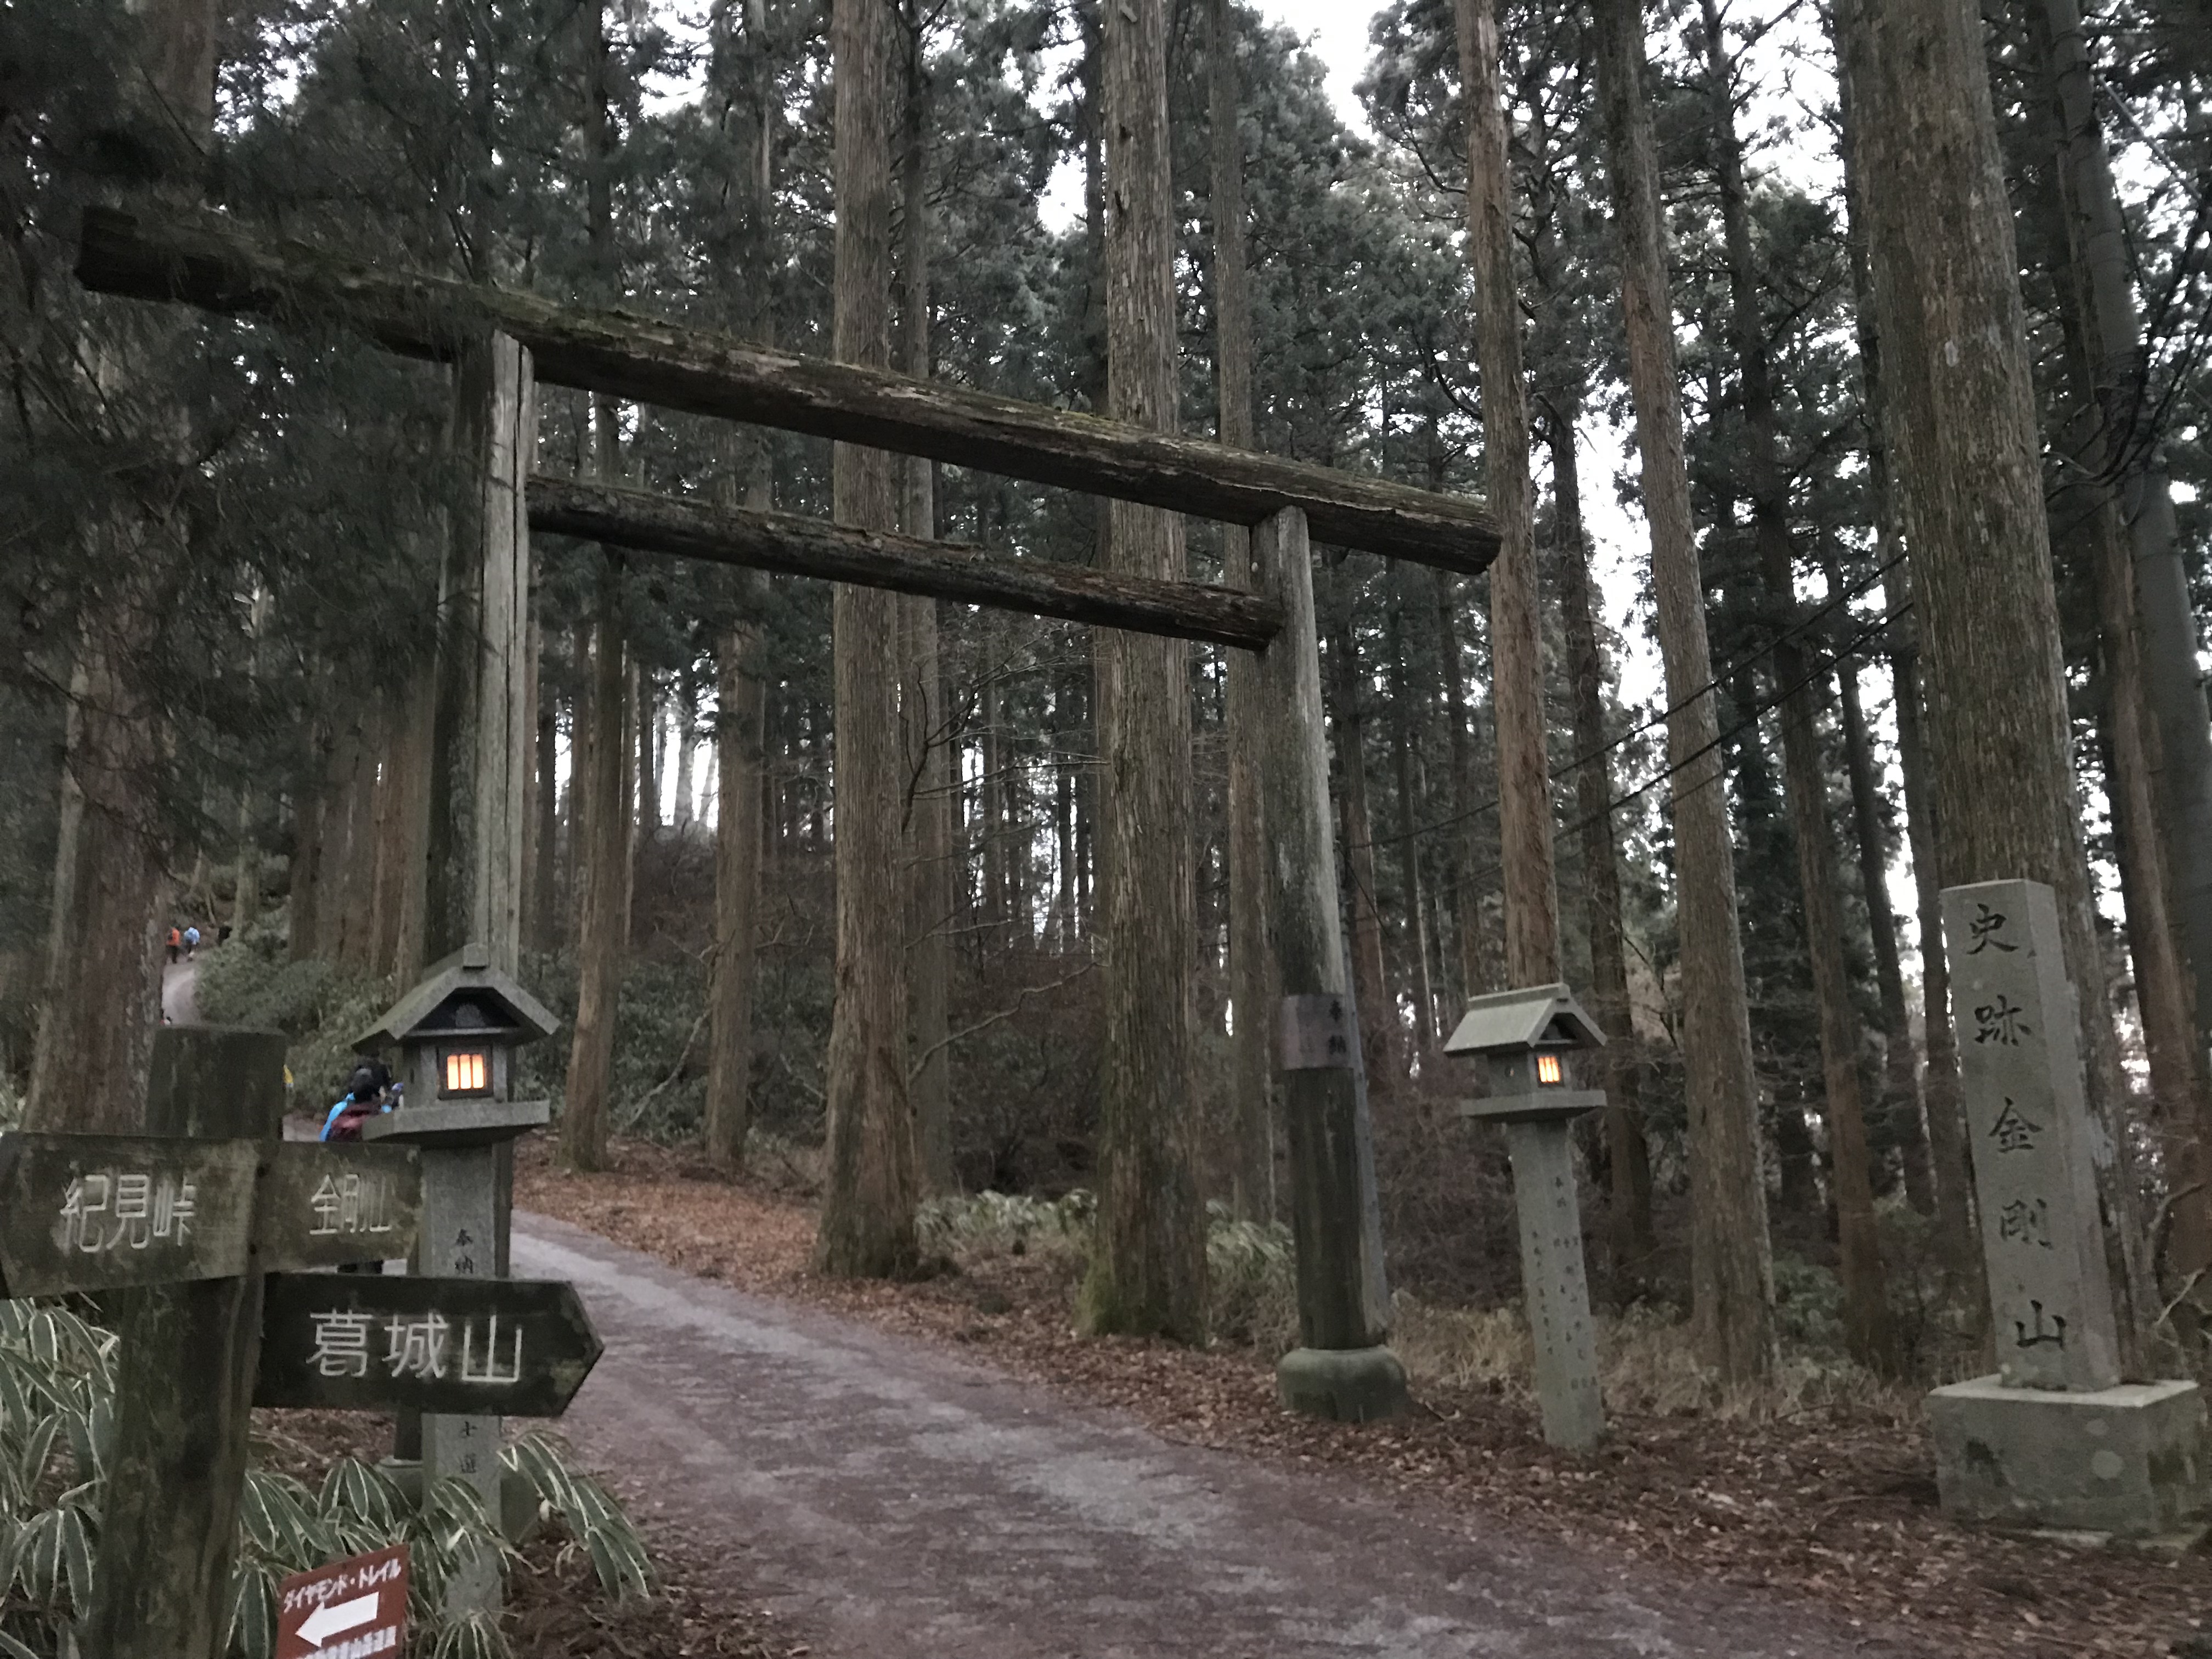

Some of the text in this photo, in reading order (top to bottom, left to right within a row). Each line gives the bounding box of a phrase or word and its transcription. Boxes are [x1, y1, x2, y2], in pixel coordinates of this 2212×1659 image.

[59, 1173, 196, 1253] 紀見峠
[306, 1308, 521, 1383] 葛城山
